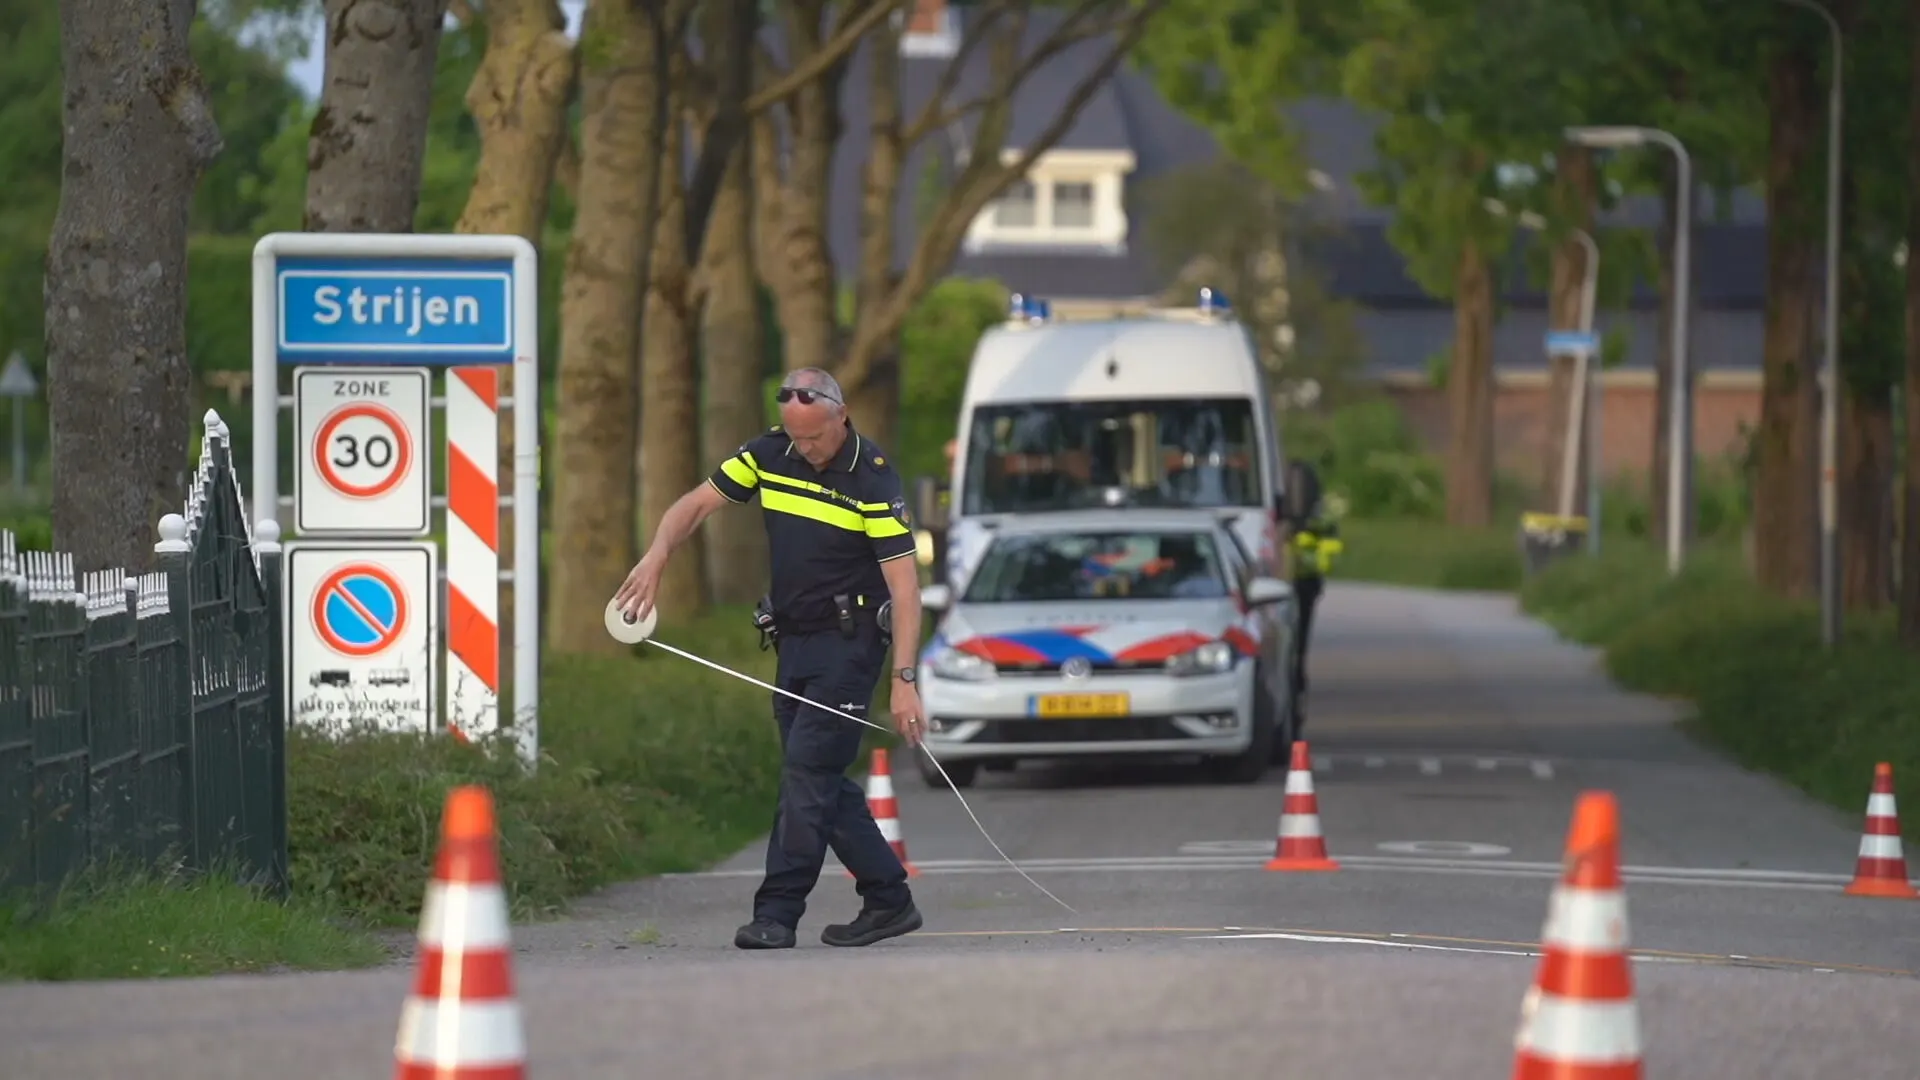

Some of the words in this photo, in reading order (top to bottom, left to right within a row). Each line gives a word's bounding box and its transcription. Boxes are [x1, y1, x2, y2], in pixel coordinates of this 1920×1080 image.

[312, 285, 480, 337] Strijen
[333, 380, 391, 396] ZONE
[333, 434, 393, 468] 30
